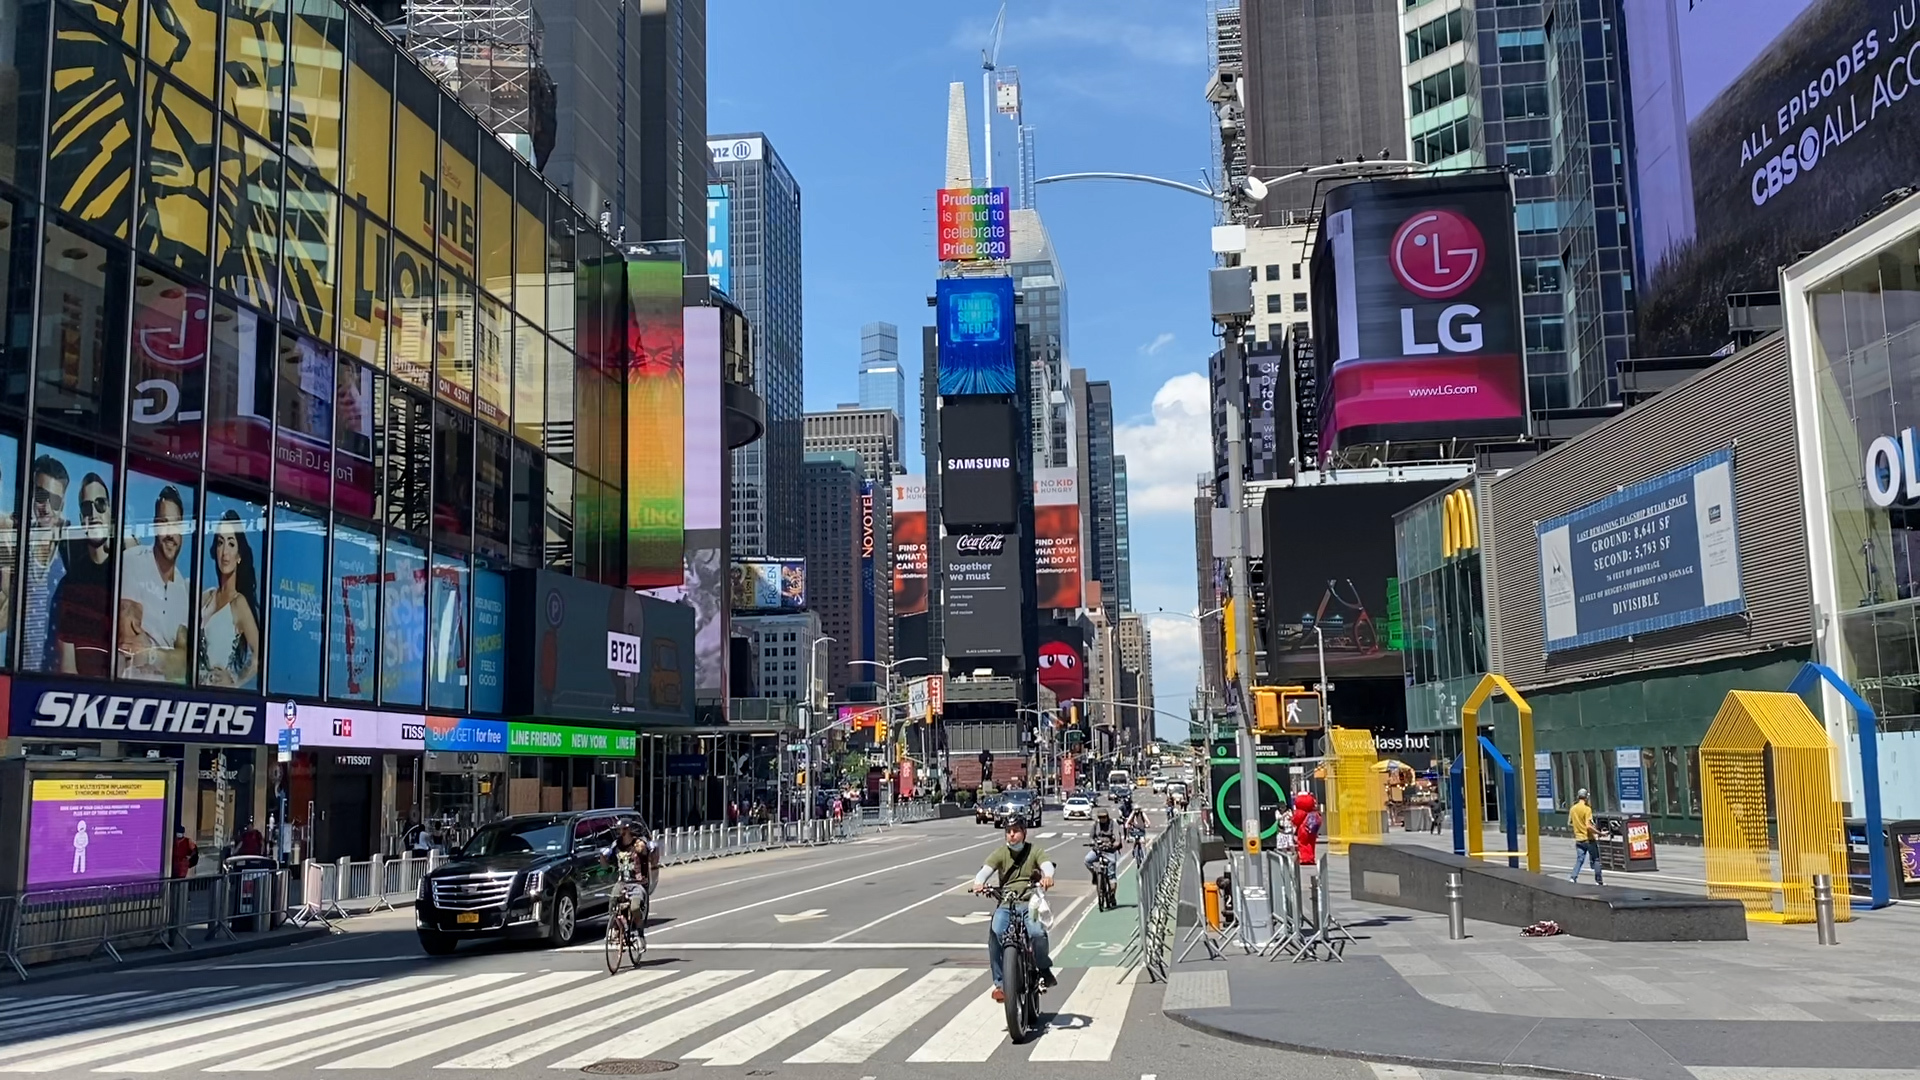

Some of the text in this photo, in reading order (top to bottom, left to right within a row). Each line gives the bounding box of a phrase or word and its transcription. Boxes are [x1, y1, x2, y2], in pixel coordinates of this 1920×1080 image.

[1740, 123, 1773, 168] ALL
[1777, 29, 1879, 135] EPISODES
[1751, 143, 1799, 206] CBS
[1822, 94, 1867, 158] ALL
[942, 191, 1004, 207] Prudential
[420, 170, 474, 255] THE
[942, 209, 1005, 224] is proud to
[943, 223, 1006, 240] celebrate
[354, 191, 450, 323] LION
[943, 242, 1006, 255] Pride 2020
[959, 322, 993, 334] MEDIA
[1400, 304, 1483, 355] LG
[392, 355, 497, 417] ENTRANCE ON 45TH STREET
[1408, 385, 1478, 397] www.LG.com
[948, 457, 1010, 470] SAMSUNG
[1056, 479, 1073, 487] KID
[861, 489, 874, 558] NOVOTEL
[1576, 493, 1688, 542] LAST REMAINING FLAGSHIP RETAIL SPACE
[956, 533, 1004, 551] Coca-Cola
[1591, 515, 1671, 553] GROUND: 8,641 SF
[899, 544, 918, 552] FIND
[1593, 535, 1671, 571] SECOND: 5,793 SF
[896, 553, 920, 562] WHAT
[896, 563, 913, 573] CAN
[949, 562, 992, 572] together
[1633, 560, 1661, 574] FRONTAGE
[1657, 572, 1668, 582] AND
[1668, 565, 1694, 578] SIGNAGE
[280, 578, 295, 592] ALL
[767, 565, 778, 605] FROZEN
[965, 572, 990, 581] must
[272, 593, 322, 616] THURSDAYS
[1612, 592, 1661, 615] DIVISIBLE
[611, 640, 637, 665] BT21
[479, 674, 497, 687] GOOD
[31, 691, 257, 736] SKECHERS
[432, 726, 450, 741] BUY
[450, 727, 456, 741] 2
[456, 728, 472, 742] GET
[476, 728, 486, 743] for
[487, 729, 502, 744] free
[511, 730, 629, 749] LINE FRIENDS NEW YORK LINE
[1405, 734, 1430, 749] hut
[347, 756, 371, 765] TISSOT
[457, 752, 479, 765] KIKO
[1226, 895, 1232, 907] 2
